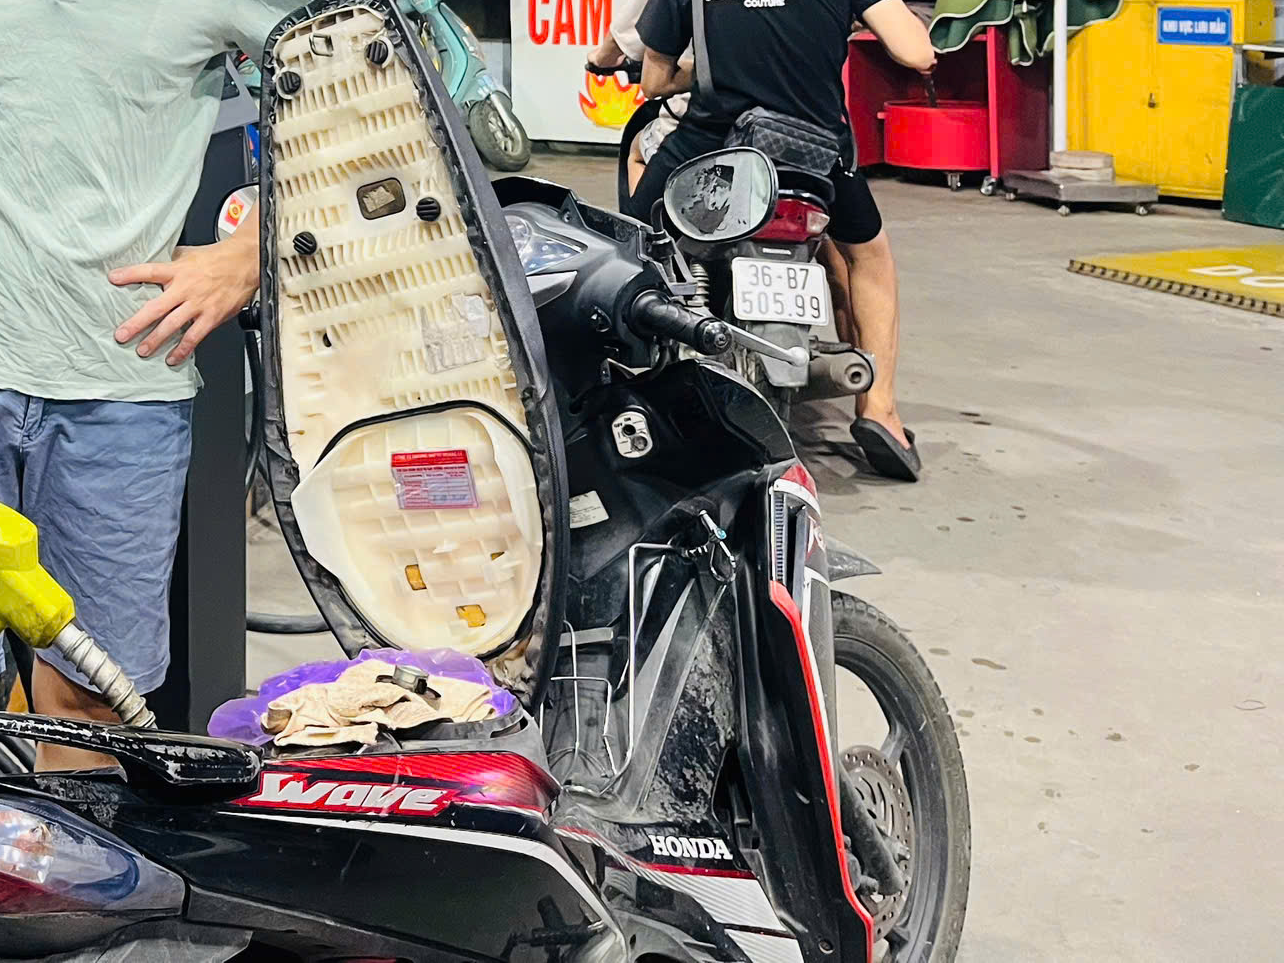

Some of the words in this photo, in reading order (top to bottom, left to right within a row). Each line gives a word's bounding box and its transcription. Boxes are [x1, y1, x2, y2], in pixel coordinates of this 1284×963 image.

[748, 263, 809, 290] 36-B7
[741, 290, 821, 319] 505.99
[648, 835, 734, 860] HONDA
